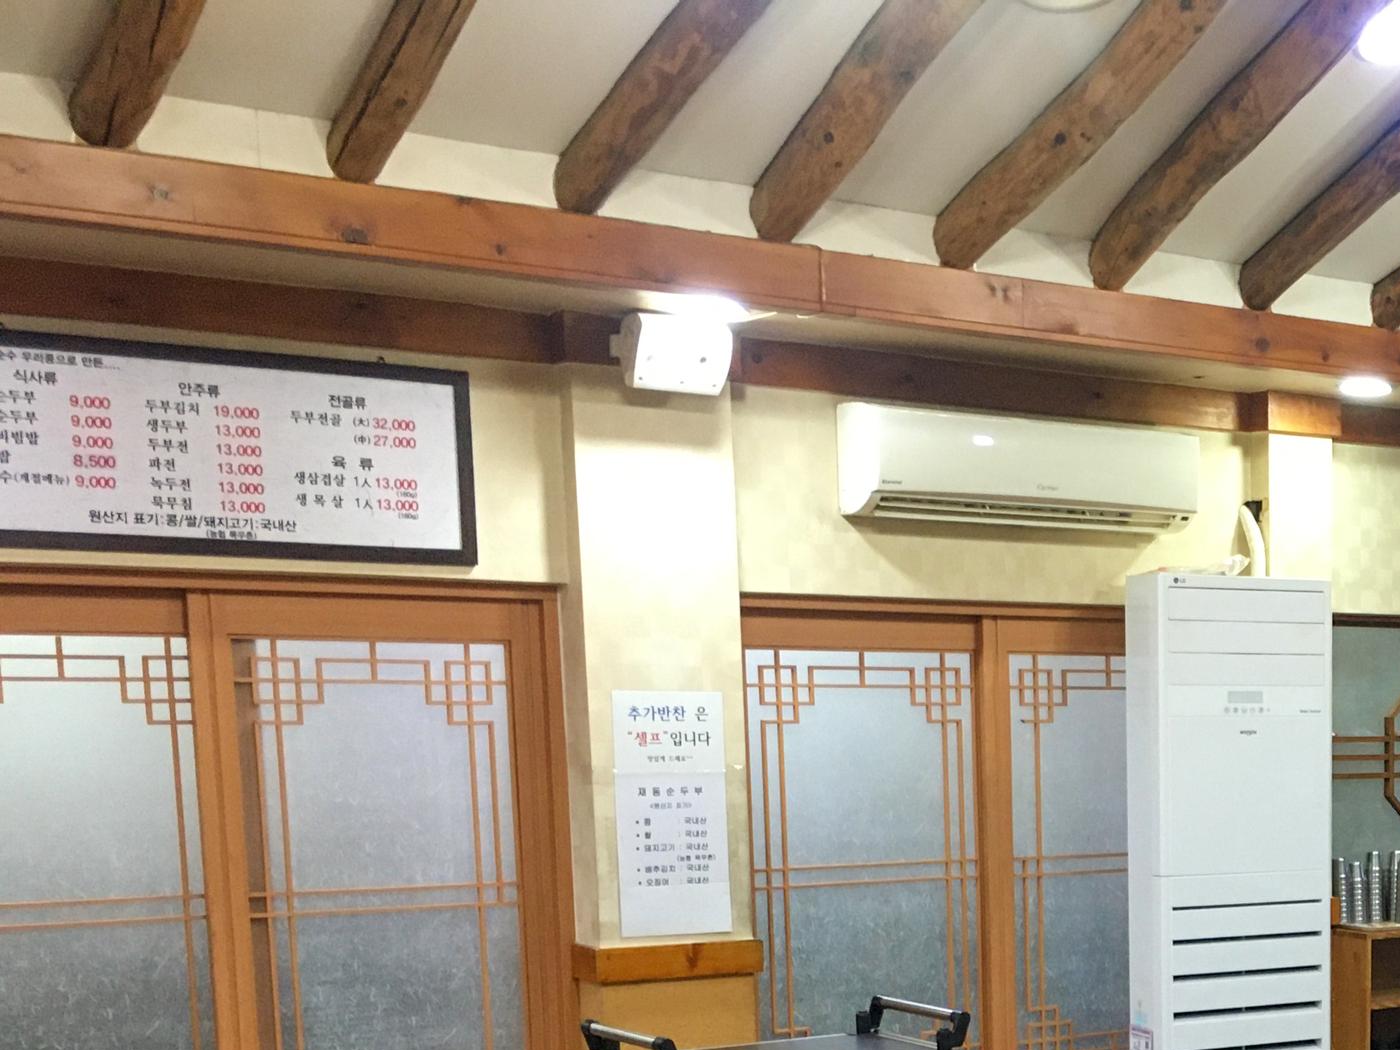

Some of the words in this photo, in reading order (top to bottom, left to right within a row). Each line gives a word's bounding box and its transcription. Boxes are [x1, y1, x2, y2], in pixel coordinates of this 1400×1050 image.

[13, 369, 57, 386] 식사류
[178, 382, 220, 398] 안주류
[145, 399, 199, 416] 두부김치
[213, 405, 259, 420] 19,000
[328, 394, 366, 410] 전골류
[147, 418, 188, 433] 생두부
[215, 425, 260, 438] 13,000
[290, 411, 342, 427] 두부전골
[373, 418, 416, 432] 32,000
[148, 438, 188, 453] 두부전
[216, 444, 262, 457] 13,000
[374, 435, 416, 449] 27,000
[149, 457, 175, 472] 파전
[218, 463, 263, 477] 13,000
[151, 476, 191, 492] 녹두전
[219, 482, 264, 495] 13,000
[294, 472, 345, 487] 생삼겹살
[375, 477, 418, 491] 13,000
[220, 501, 265, 514] 13,000
[377, 499, 419, 512] 13,000
[89, 509, 127, 524] 원산지
[628, 705, 687, 722] 추가반찬
[695, 706, 709, 722] 은
[684, 817, 707, 825] 국내산
[685, 830, 708, 838] 국내산
[686, 842, 708, 851] 국내산
[687, 863, 709, 872] 국내산
